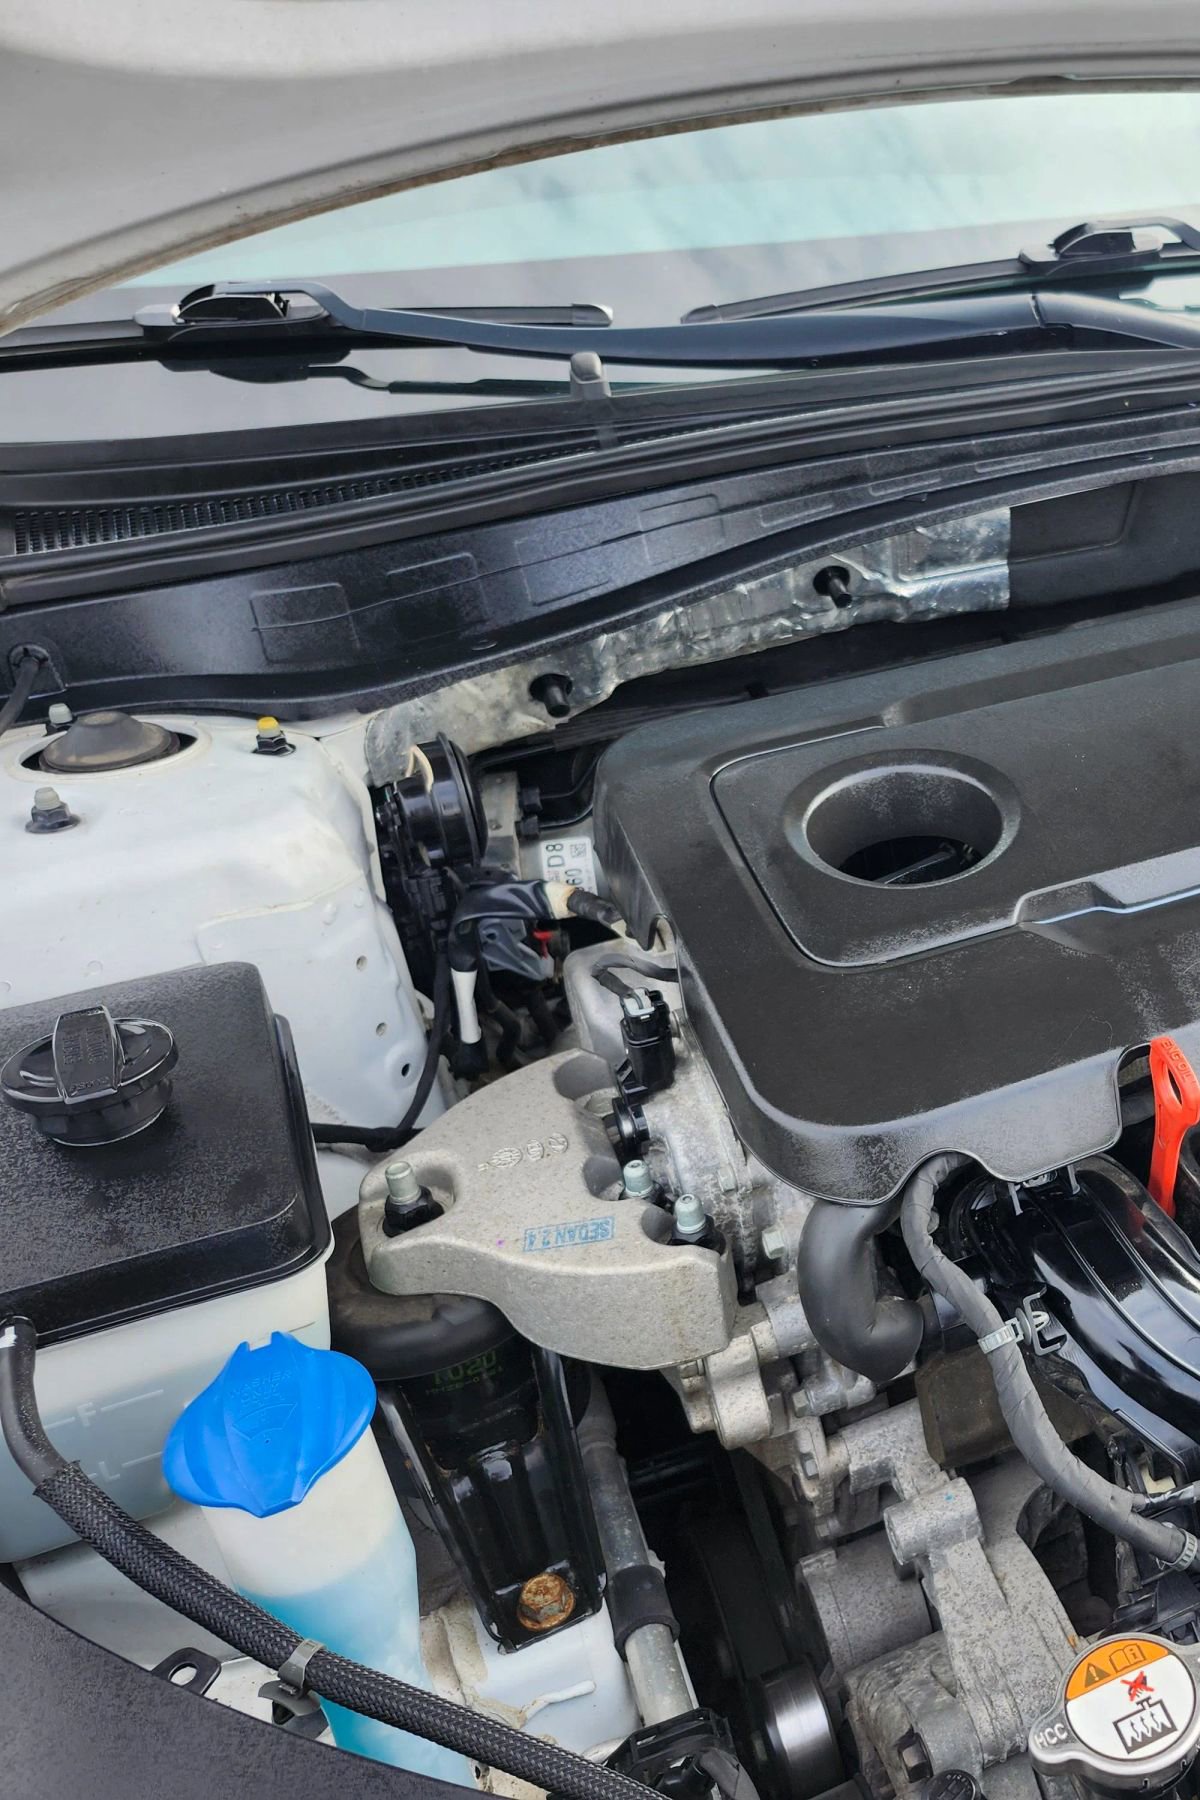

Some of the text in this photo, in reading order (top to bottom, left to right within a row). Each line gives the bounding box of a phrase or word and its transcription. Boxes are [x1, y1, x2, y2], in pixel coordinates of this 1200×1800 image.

[1161, 1040, 1195, 1083] ENG OIL
[554, 1218, 611, 1245] SEDAN
[76, 1401, 97, 1427] F
[98, 1460, 121, 1483] L
[1033, 1722, 1069, 1750] HCC
